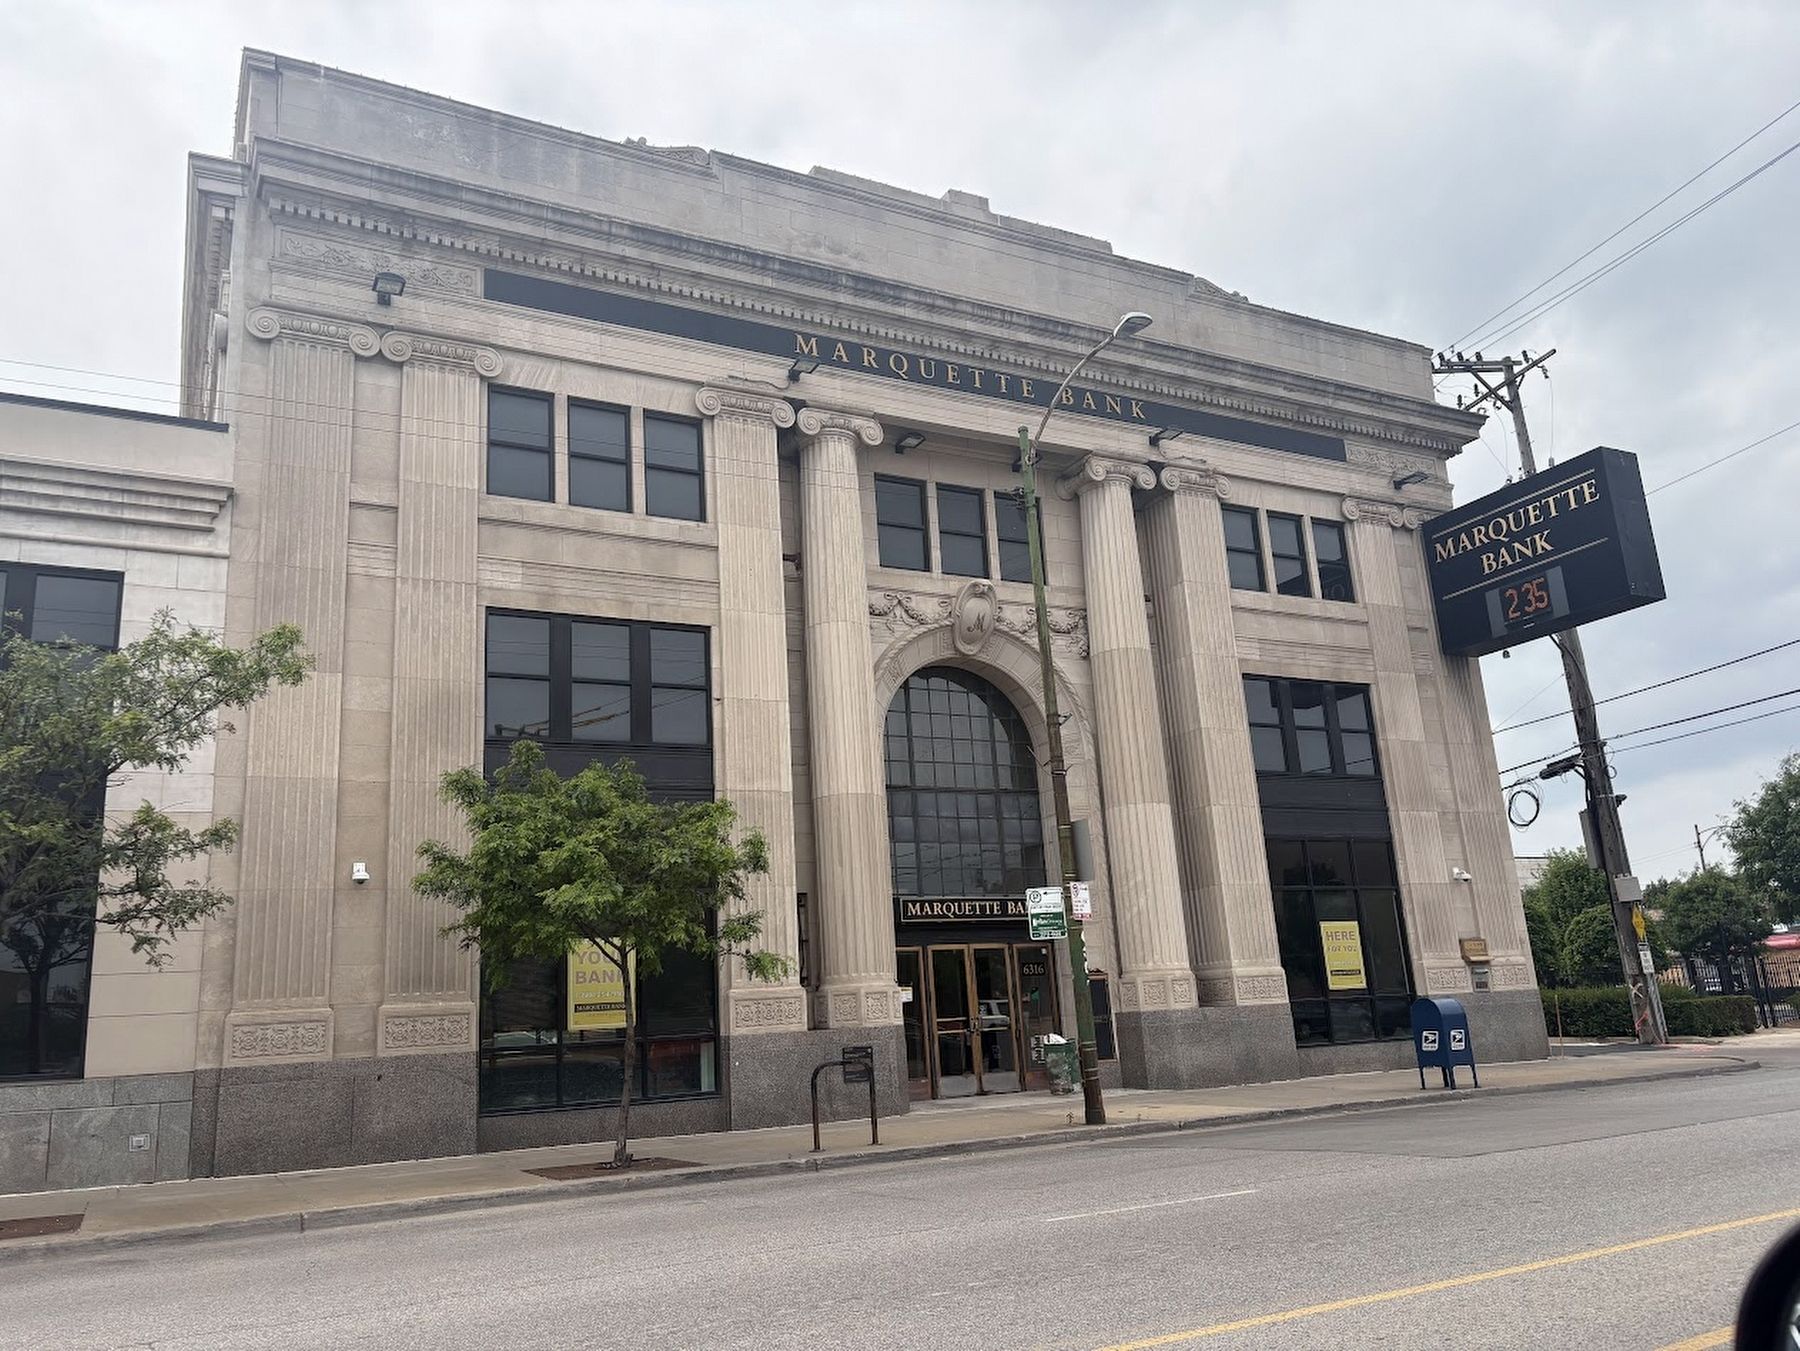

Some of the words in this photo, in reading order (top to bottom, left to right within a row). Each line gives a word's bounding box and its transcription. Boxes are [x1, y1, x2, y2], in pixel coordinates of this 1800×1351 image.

[794, 333, 1036, 399] MARQUETTE
[1060, 387, 1146, 420] BANK
[1433, 478, 1600, 563] MARQUETTE
[1480, 529, 1554, 576] BANK
[907, 901, 1001, 917] MARQUETTE
[1007, 901, 1027, 914] BA
[1326, 930, 1356, 941] HERE
[1023, 963, 1044, 975] 6316
